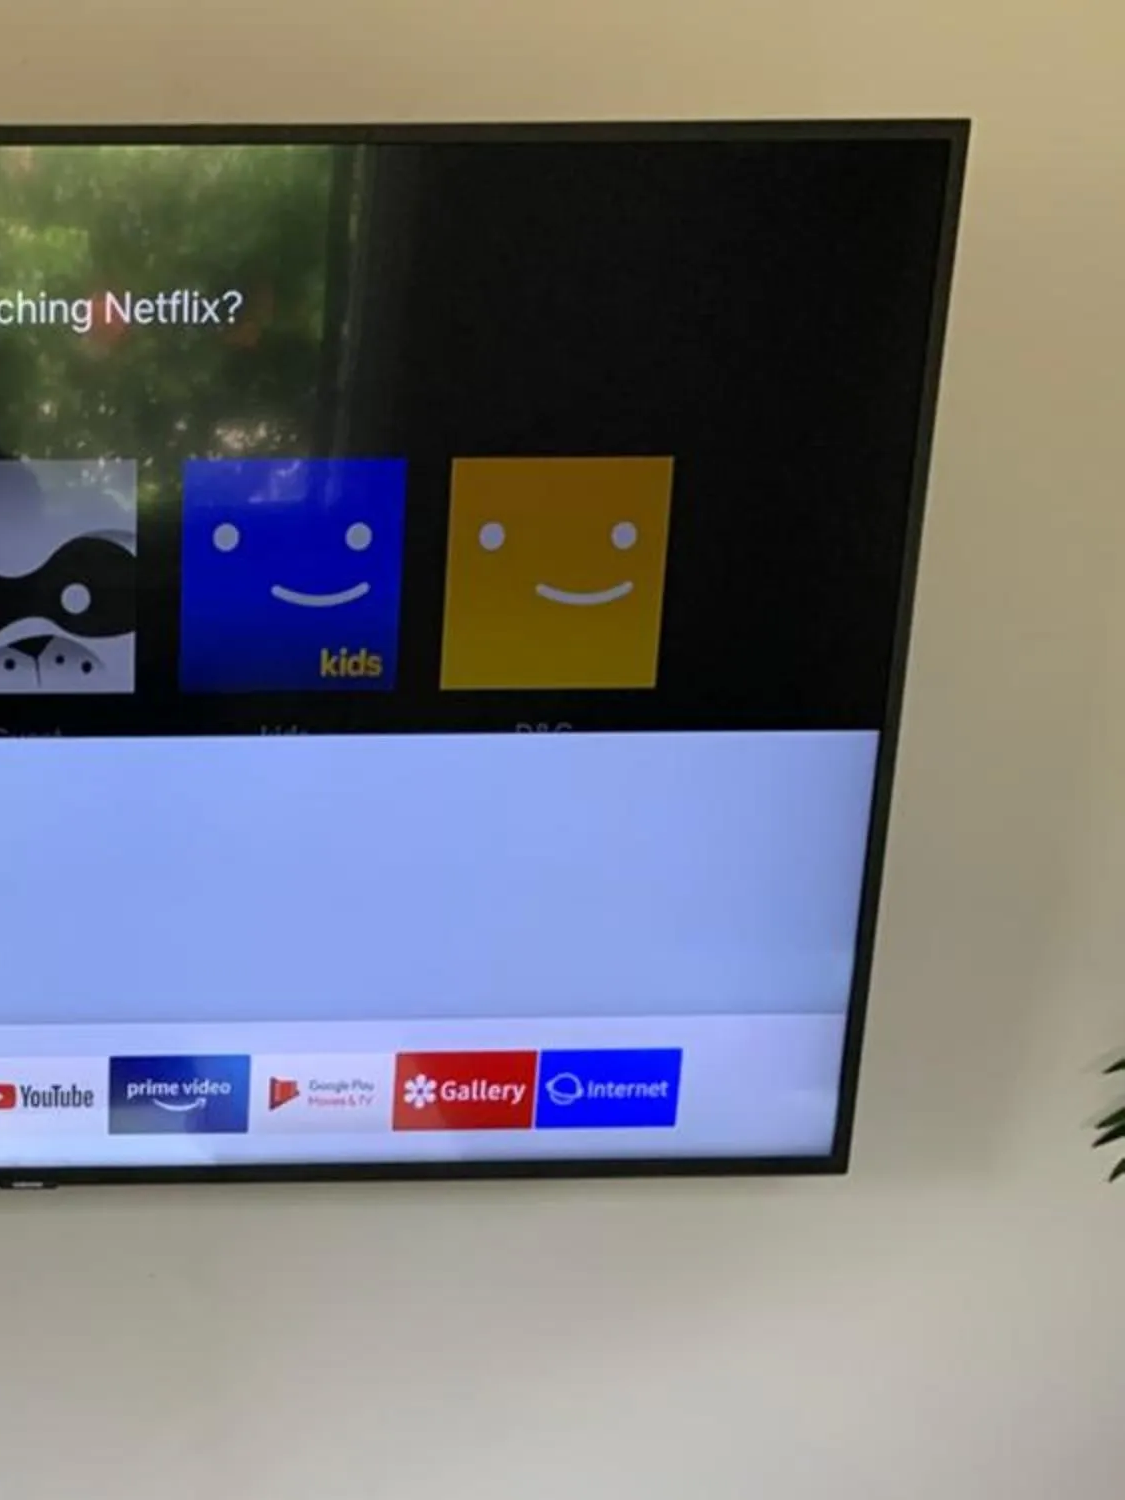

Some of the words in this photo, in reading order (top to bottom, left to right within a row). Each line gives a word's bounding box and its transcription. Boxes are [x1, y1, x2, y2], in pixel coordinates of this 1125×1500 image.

[104, 290, 244, 326] Netflix?
[319, 647, 382, 678] kids
[20, 1083, 96, 1109] YouTube
[126, 1078, 179, 1100] prime
[182, 1078, 232, 1096] video
[439, 1079, 527, 1106] Gallery
[586, 1079, 670, 1099] Internet
